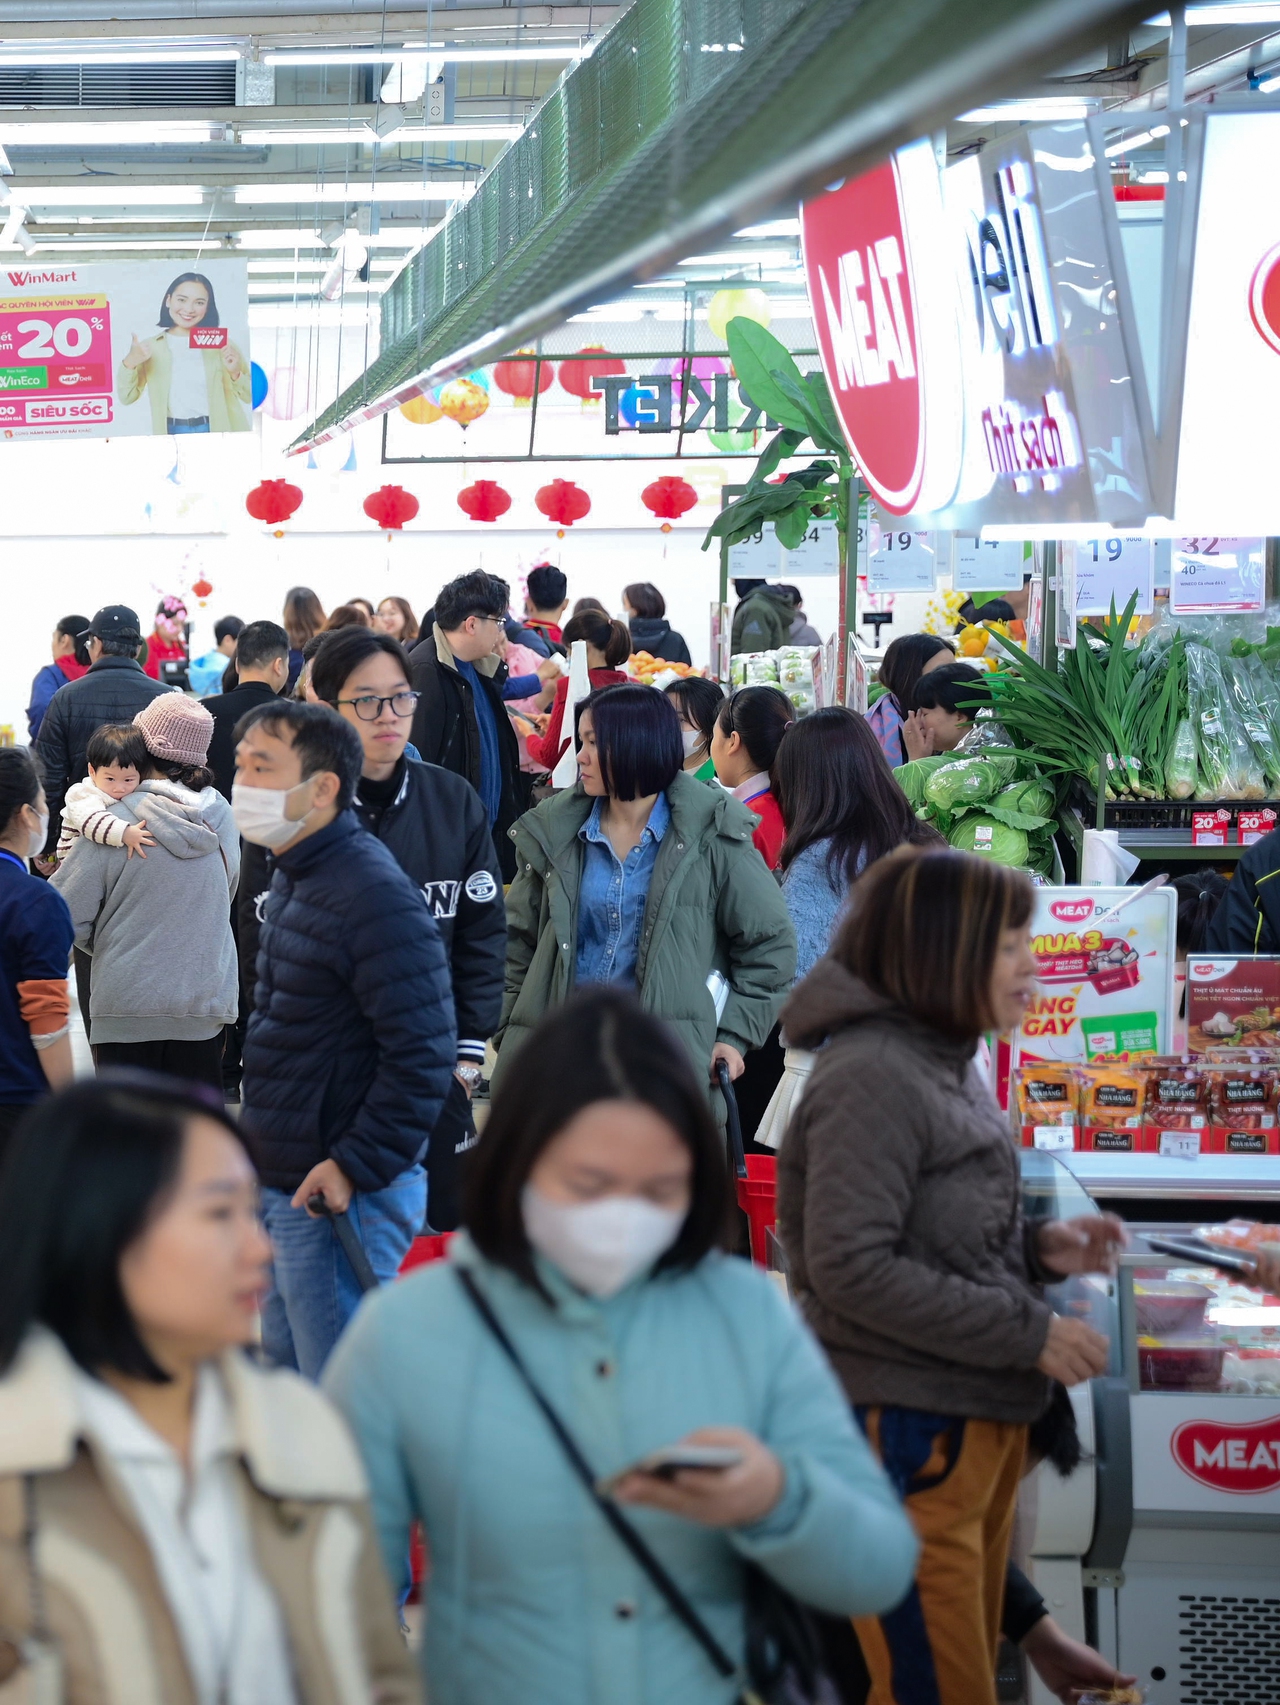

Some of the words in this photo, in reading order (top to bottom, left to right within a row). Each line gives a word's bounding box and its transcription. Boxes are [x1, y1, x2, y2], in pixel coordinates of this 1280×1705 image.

[7, 271, 77, 287] WinMart
[39, 300, 53, 308] HỘI
[54, 299, 73, 307] VIÊN
[818, 236, 916, 391] MEAT
[30, 404, 66, 418] SIÊU
[69, 401, 103, 417] SỐC
[883, 531, 912, 551] 19
[1087, 537, 1123, 562] 19
[1181, 565, 1196, 575] 40
[1056, 906, 1090, 916] MEAT
[1029, 932, 1082, 954] MUA
[1083, 930, 1102, 950] 3
[1023, 1018, 1076, 1036] GAY
